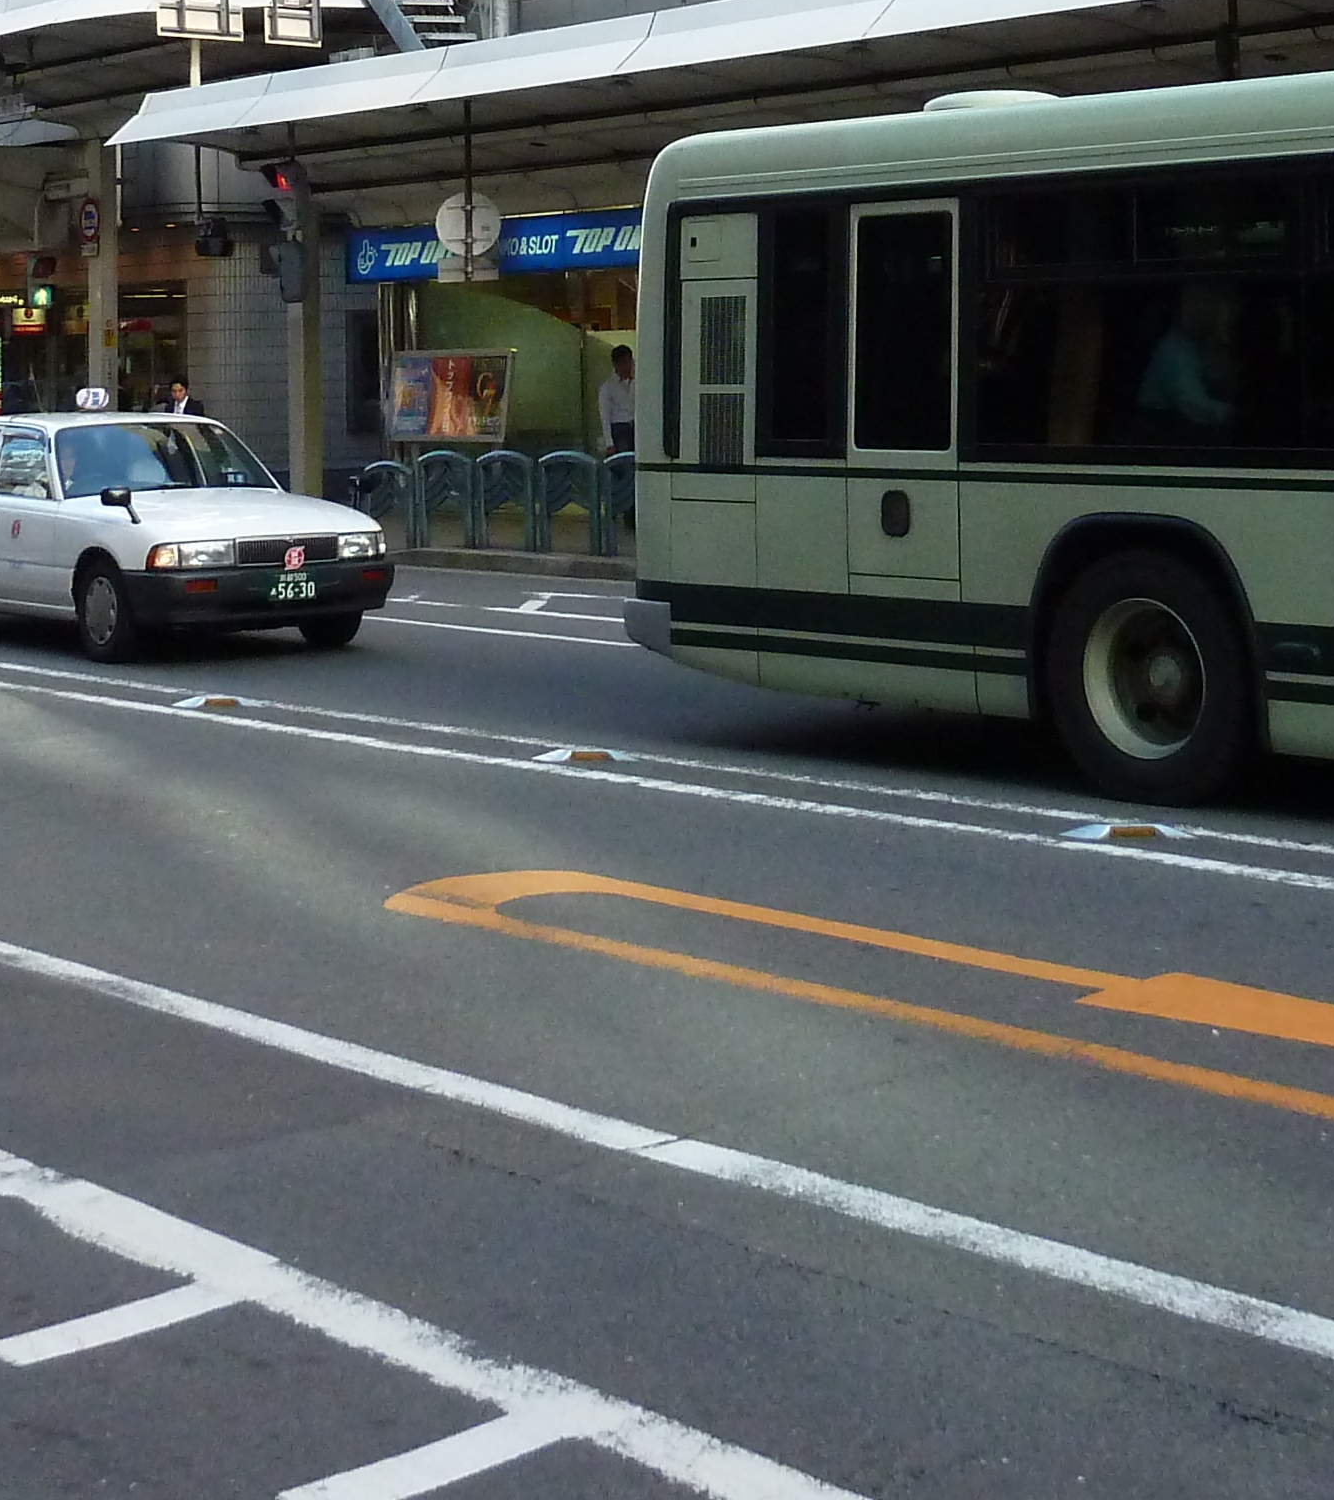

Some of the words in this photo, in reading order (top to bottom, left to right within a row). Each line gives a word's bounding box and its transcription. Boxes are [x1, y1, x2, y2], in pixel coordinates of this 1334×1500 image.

[380, 241, 422, 266] TOP
[528, 234, 560, 255] SLOT
[566, 227, 616, 255] TOP
